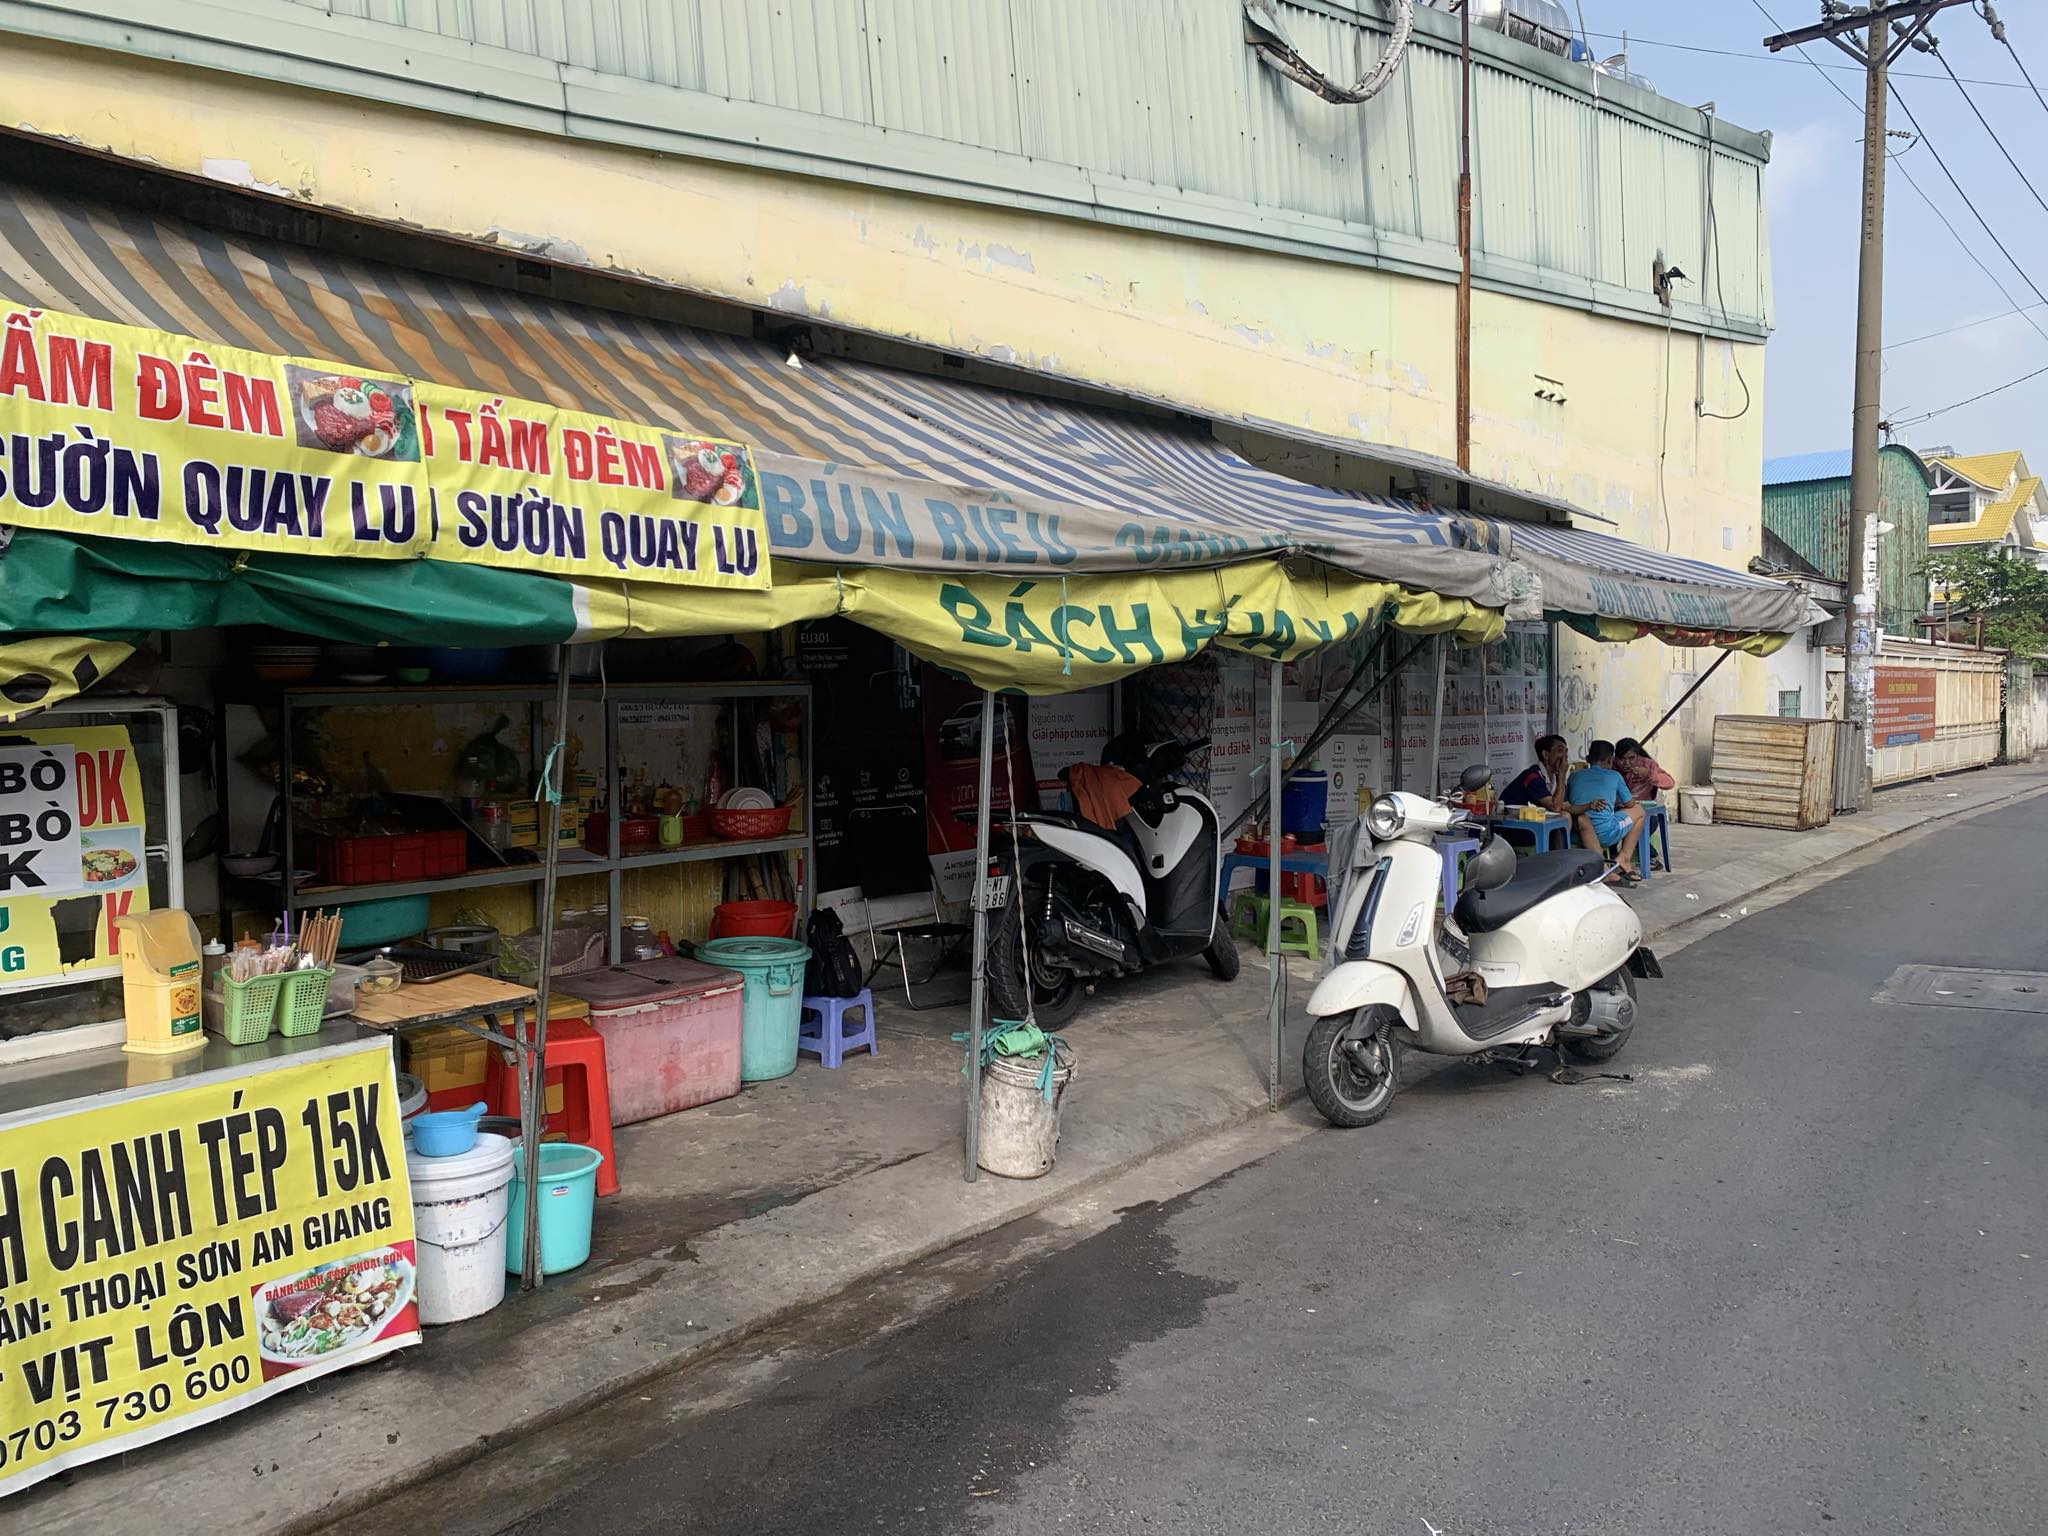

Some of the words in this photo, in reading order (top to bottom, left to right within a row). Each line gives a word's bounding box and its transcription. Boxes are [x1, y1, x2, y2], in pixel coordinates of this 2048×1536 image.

[137, 351, 285, 437] ĐÊM
[0, 425, 160, 519] ƯỜN
[183, 461, 331, 541] QUAY
[350, 482, 417, 544] LU
[451, 399, 551, 475] TẤM
[564, 426, 664, 493] ĐÊM
[458, 487, 586, 560] SƯỜN
[602, 511, 699, 573] QUAY
[713, 525, 758, 577] LU
[759, 463, 916, 559] BÚN
[938, 581, 1168, 665] BÁCH
[0, 750, 66, 794] BÒ
[0, 800, 72, 847] BÒ
[40, 1128, 193, 1273] CANH
[198, 1090, 287, 1227] TÉP
[301, 1083, 391, 1197] 15K
[60, 1260, 167, 1325] THOẠI
[178, 1236, 243, 1290] SƠN
[252, 1219, 294, 1268] AN
[303, 1197, 392, 1251] GIANG
[22, 1336, 113, 1404] VỊT
[137, 1296, 246, 1368] LỘN
[0, 1410, 82, 1470] 703
[95, 1383, 172, 1432] 730
[185, 1354, 251, 1401] 600
